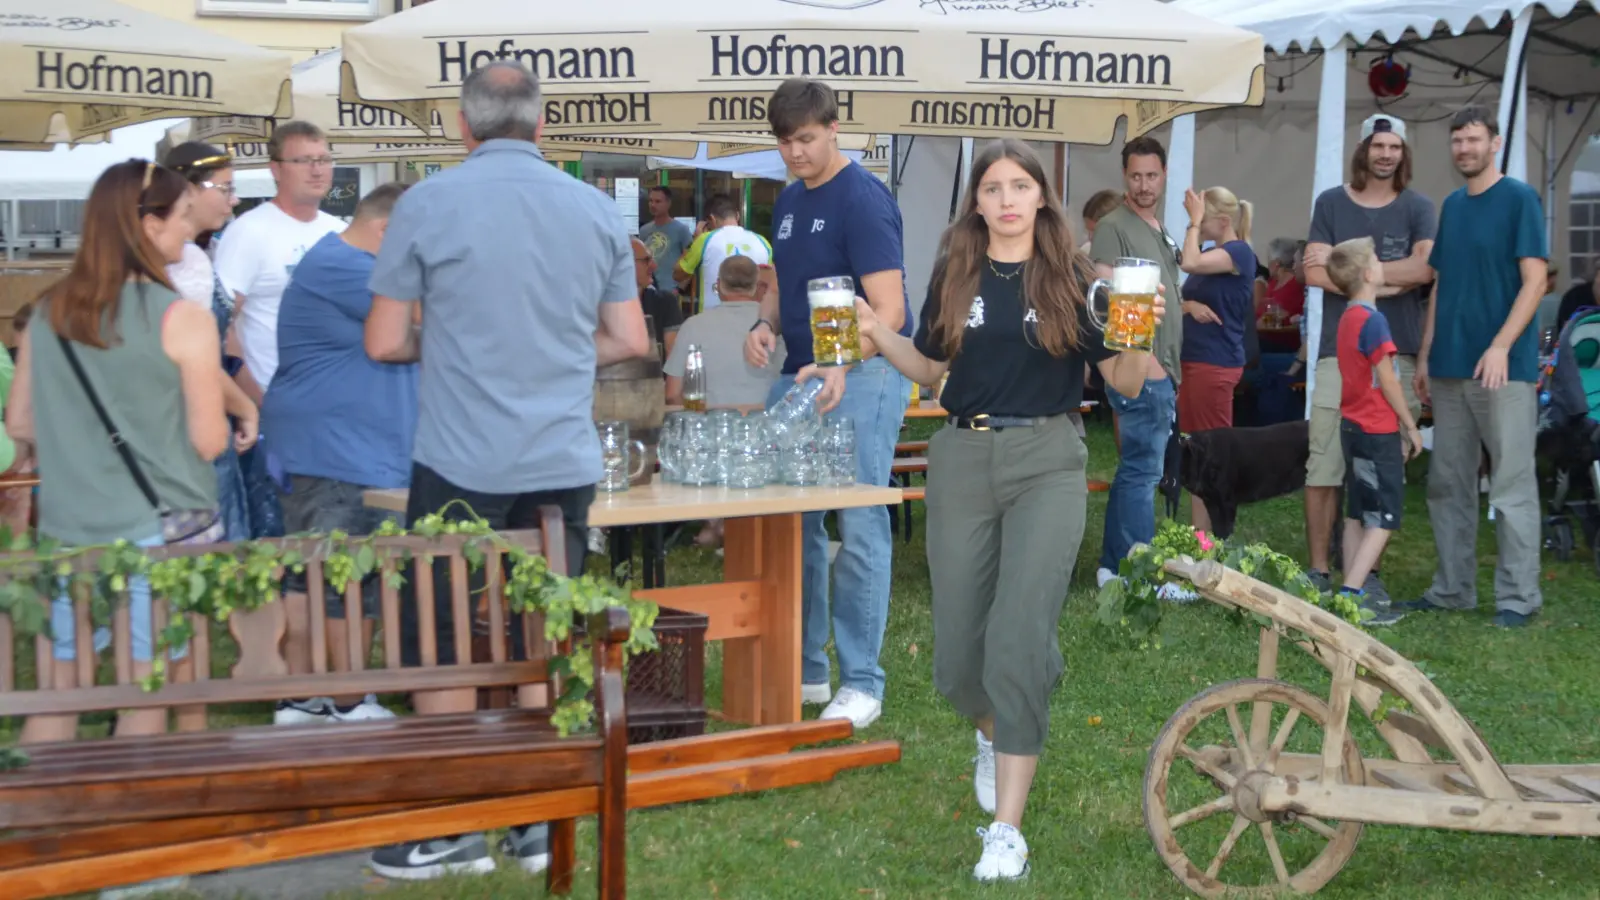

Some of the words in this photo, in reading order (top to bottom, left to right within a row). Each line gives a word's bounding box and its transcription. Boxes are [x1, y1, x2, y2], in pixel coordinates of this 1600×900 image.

[37, 51, 214, 99] Hofmann
[436, 39, 636, 82] Hofmann
[711, 34, 906, 77] Hofmann
[979, 37, 1172, 86] Hofmann
